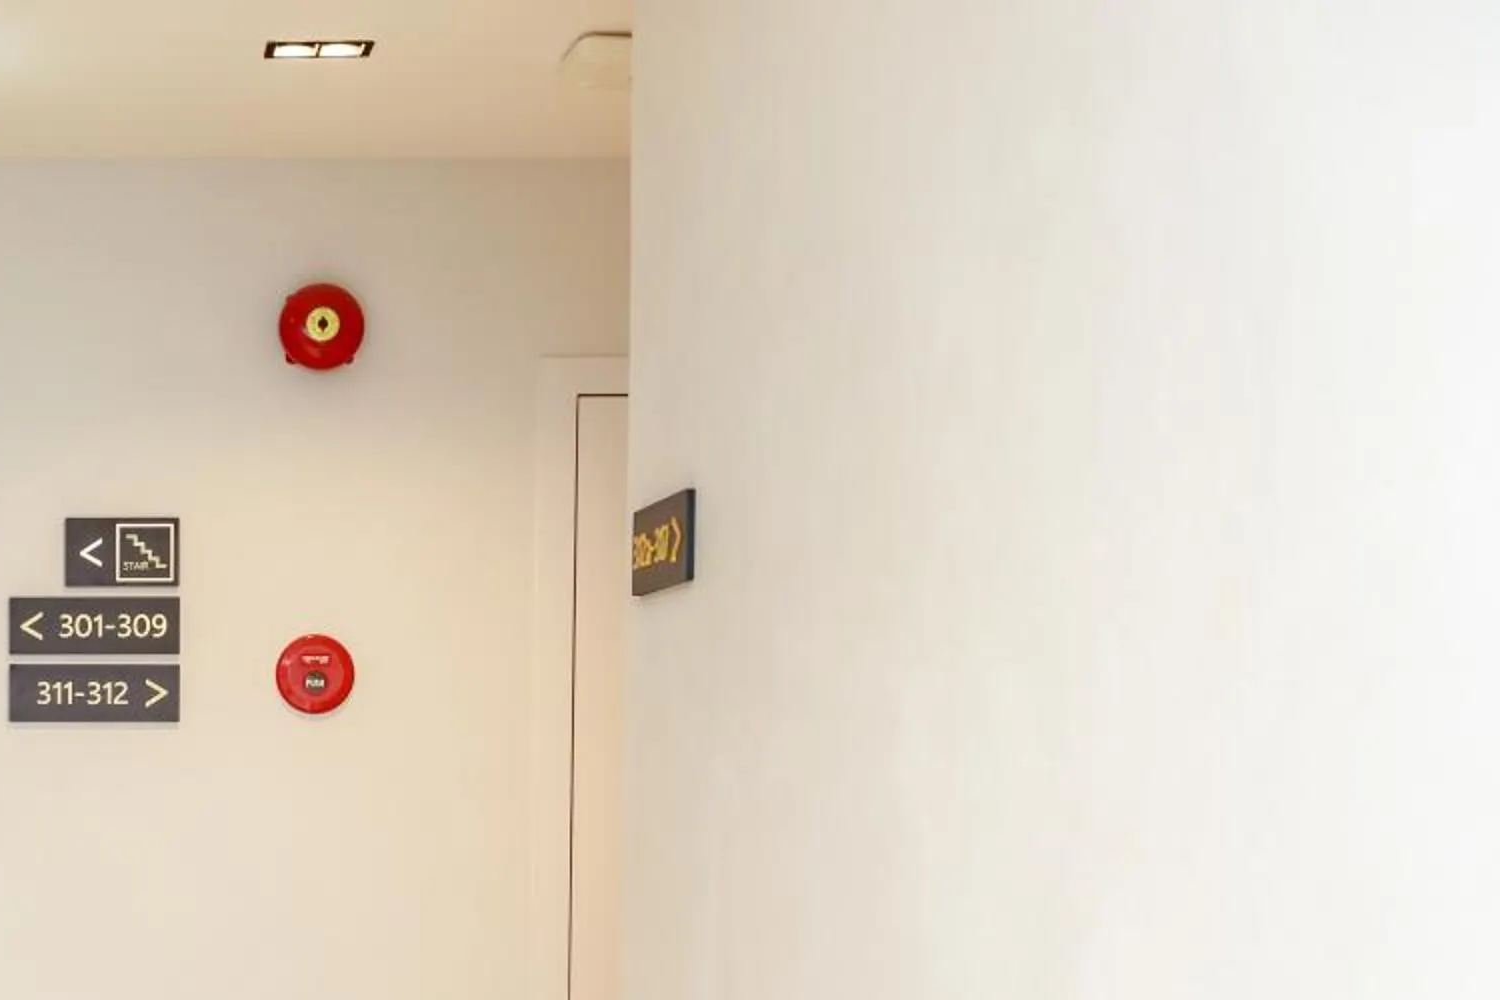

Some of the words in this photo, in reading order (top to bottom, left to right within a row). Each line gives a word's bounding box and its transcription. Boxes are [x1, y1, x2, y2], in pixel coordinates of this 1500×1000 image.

[122, 561, 149, 572] STAIR
[58, 613, 168, 639] 301-309
[36, 681, 129, 705] 311-312
